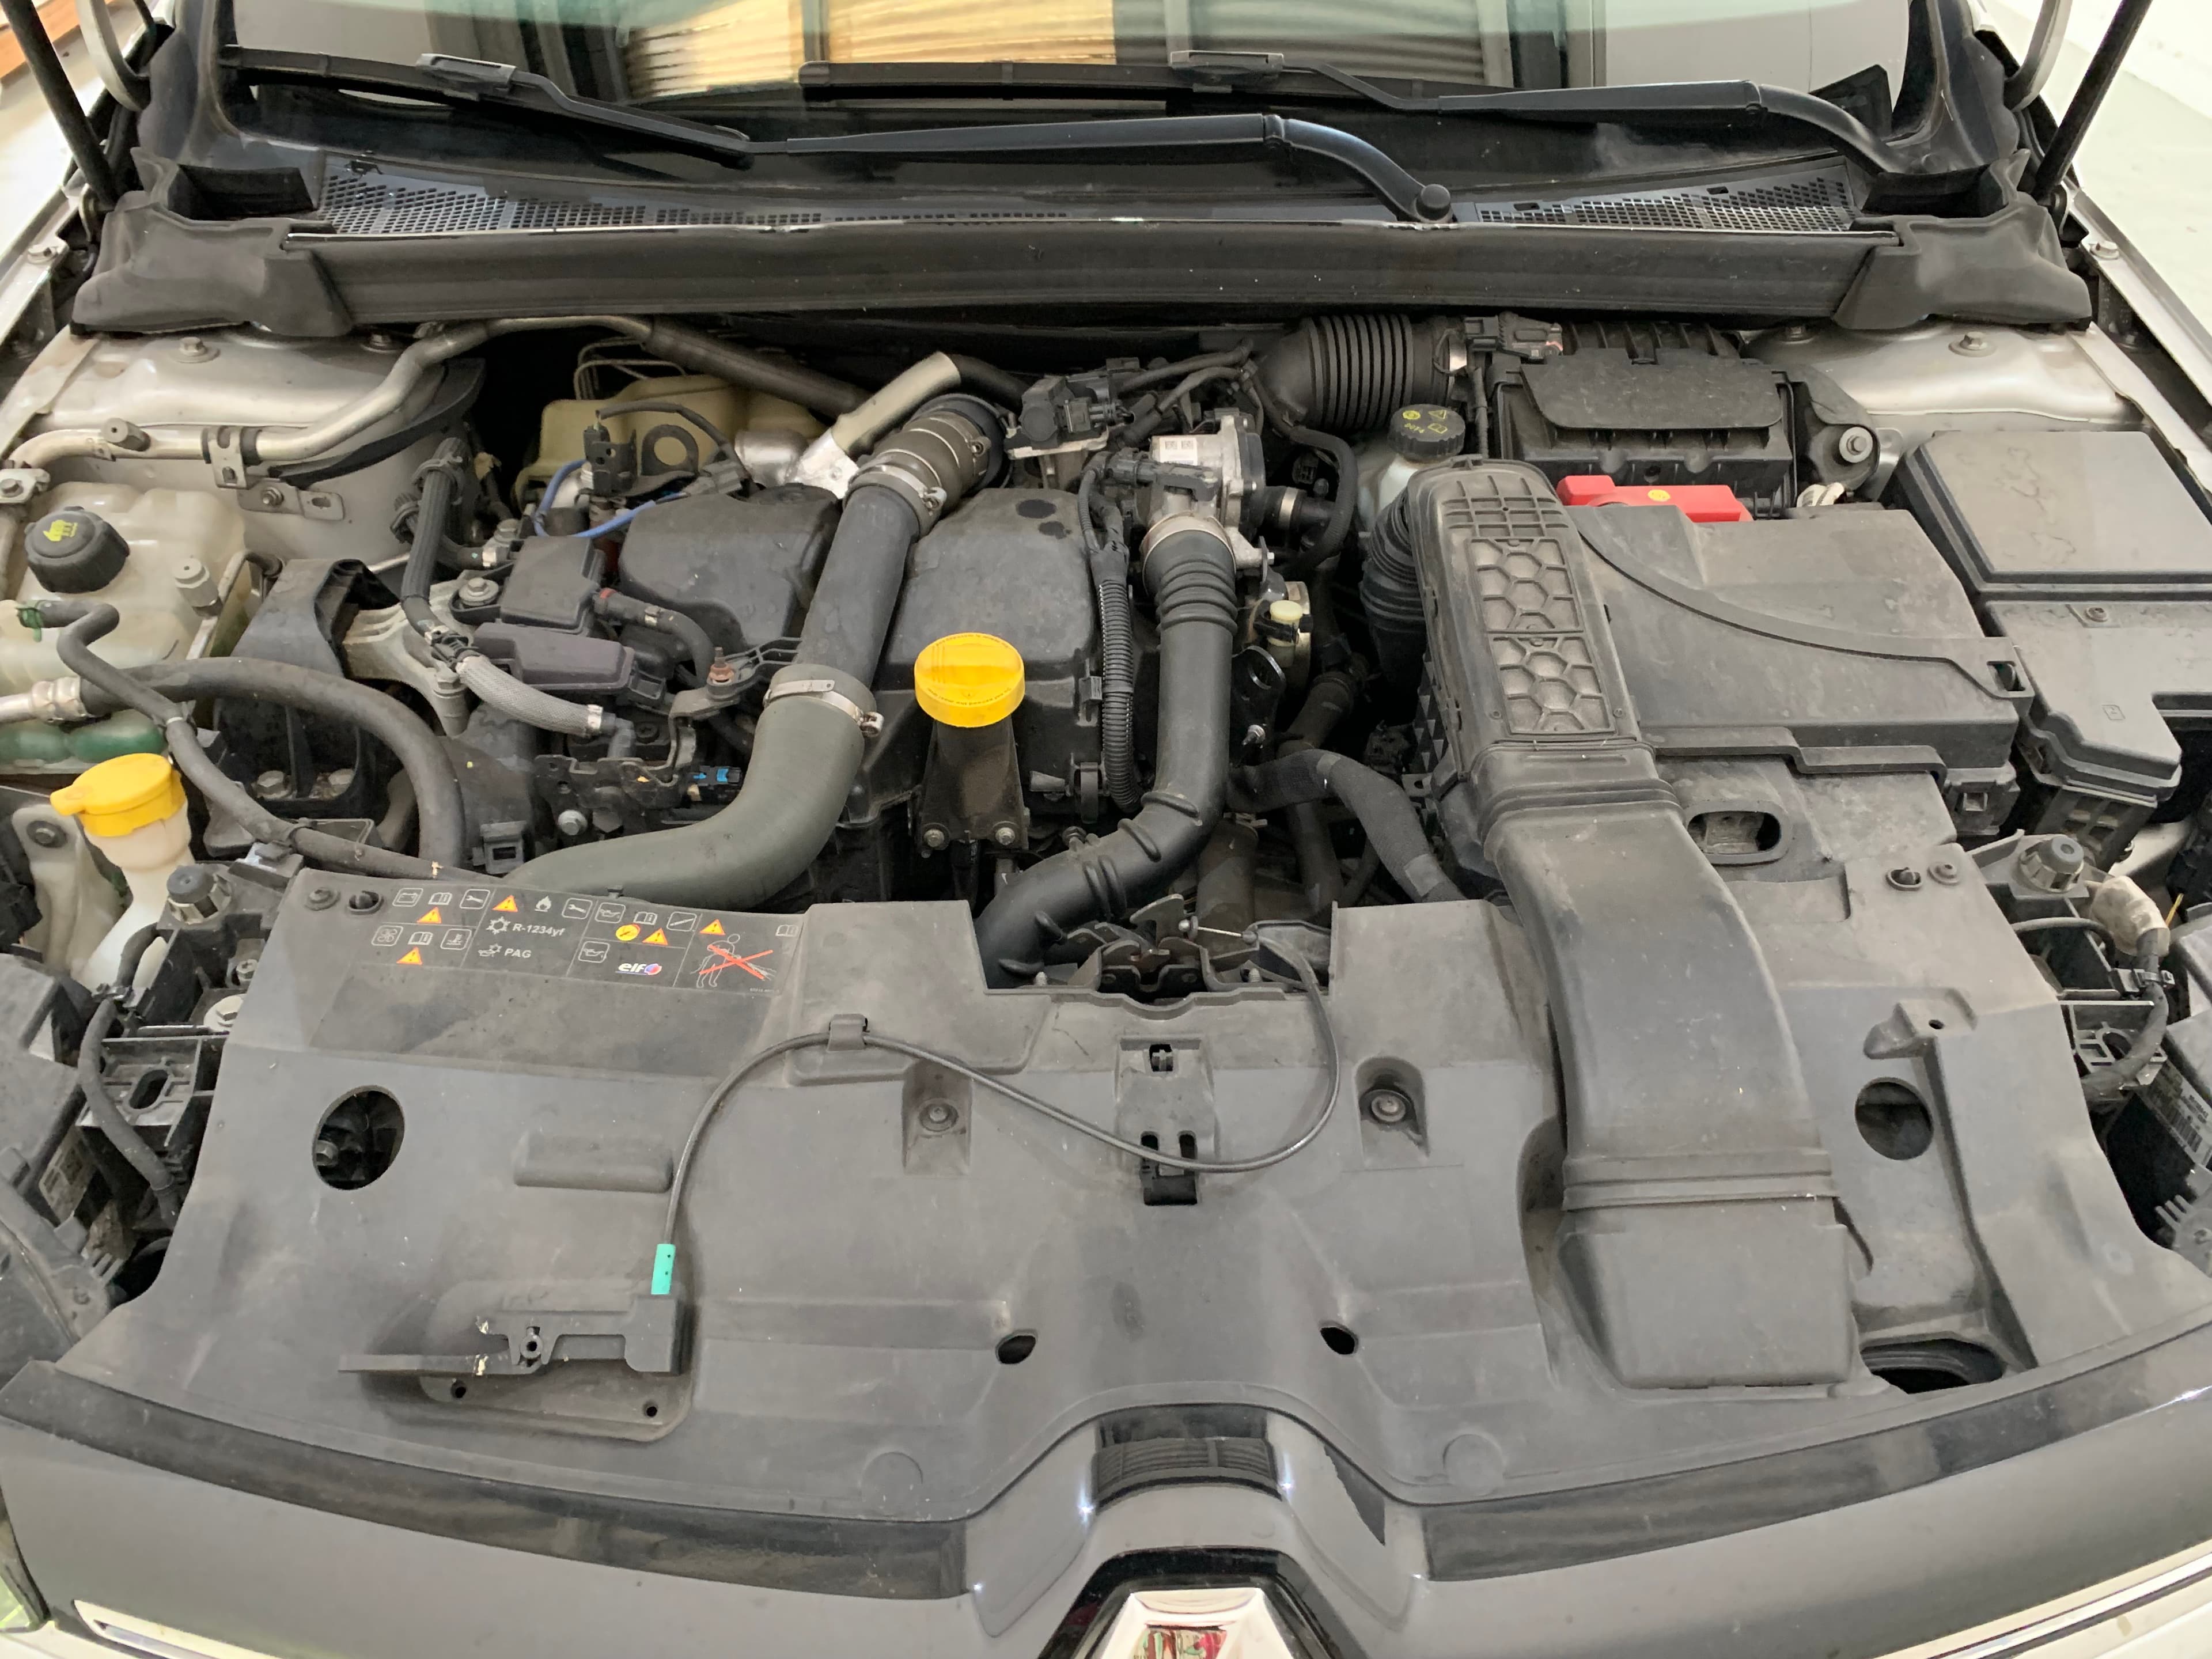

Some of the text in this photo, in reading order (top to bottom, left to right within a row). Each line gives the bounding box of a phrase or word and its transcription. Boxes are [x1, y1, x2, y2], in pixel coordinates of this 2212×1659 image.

[512, 923, 566, 937] R-1234yf
[504, 948, 532, 959] PAG
[618, 963, 646, 973] elf
